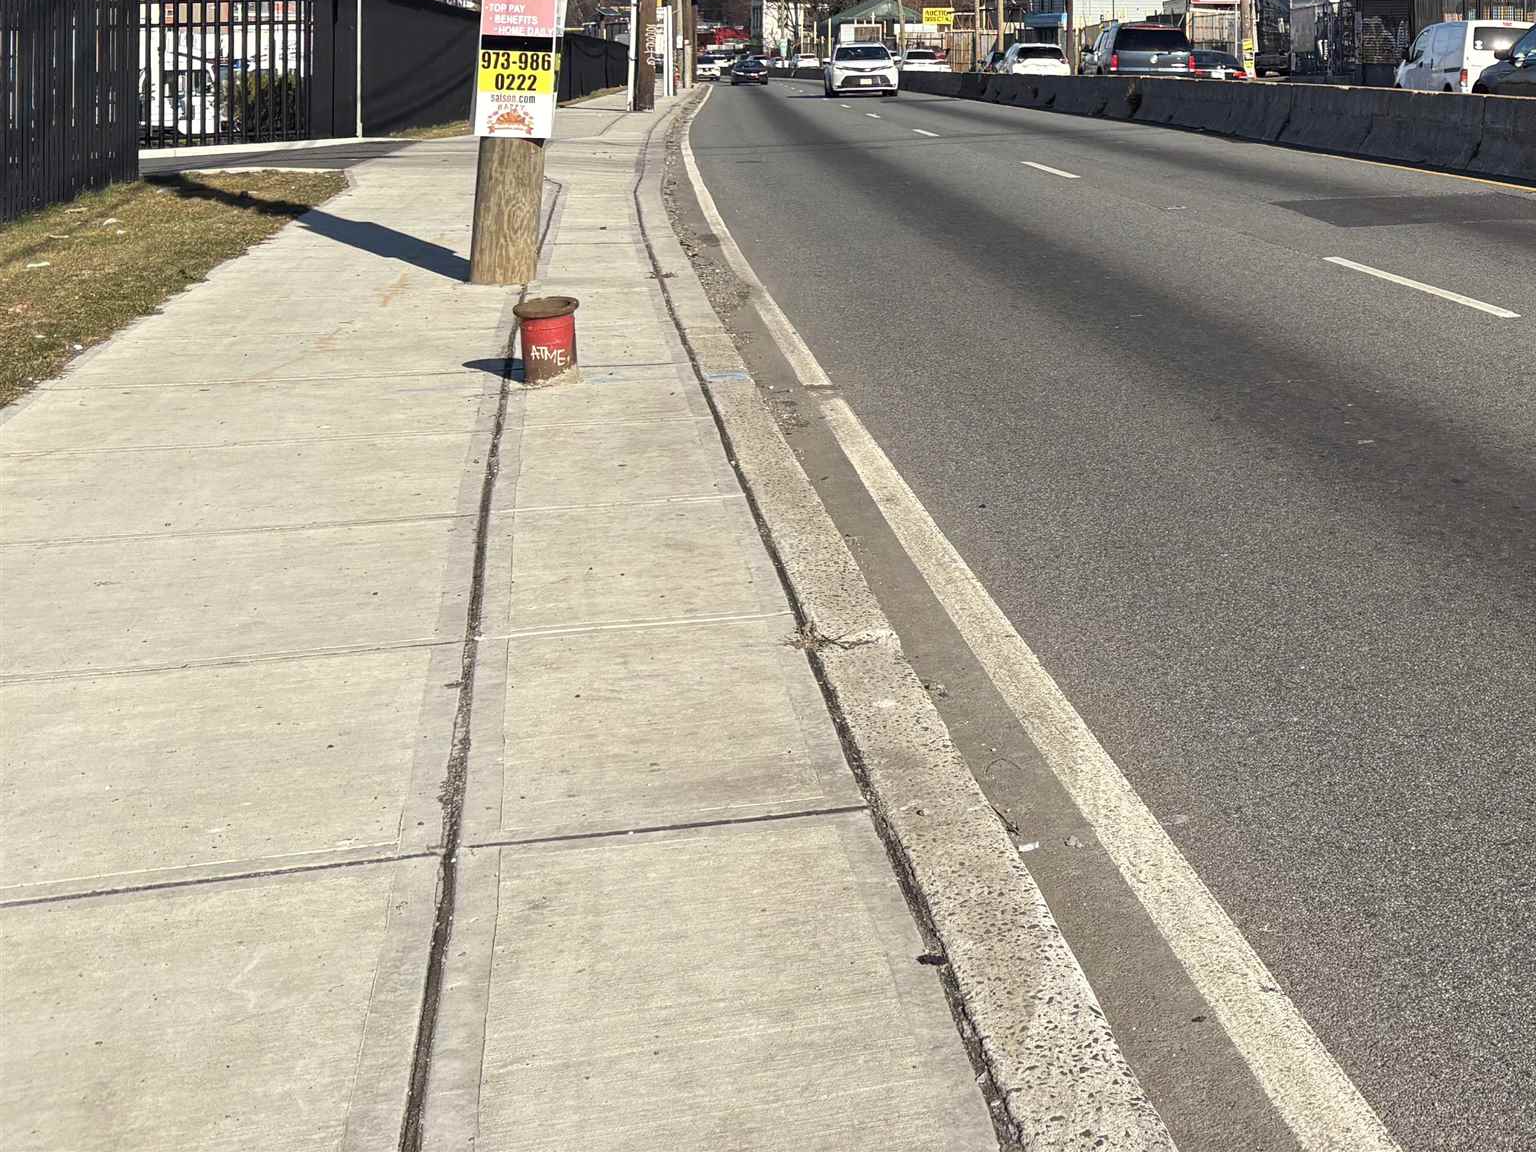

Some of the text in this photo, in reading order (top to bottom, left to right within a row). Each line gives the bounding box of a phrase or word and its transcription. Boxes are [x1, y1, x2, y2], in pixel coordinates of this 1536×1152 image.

[489, 3, 526, 14] TOP PAY
[494, 14, 538, 25] BENEFITS
[499, 26, 525, 36] HOME
[481, 51, 552, 71] 973-986
[495, 73, 537, 91] 0222
